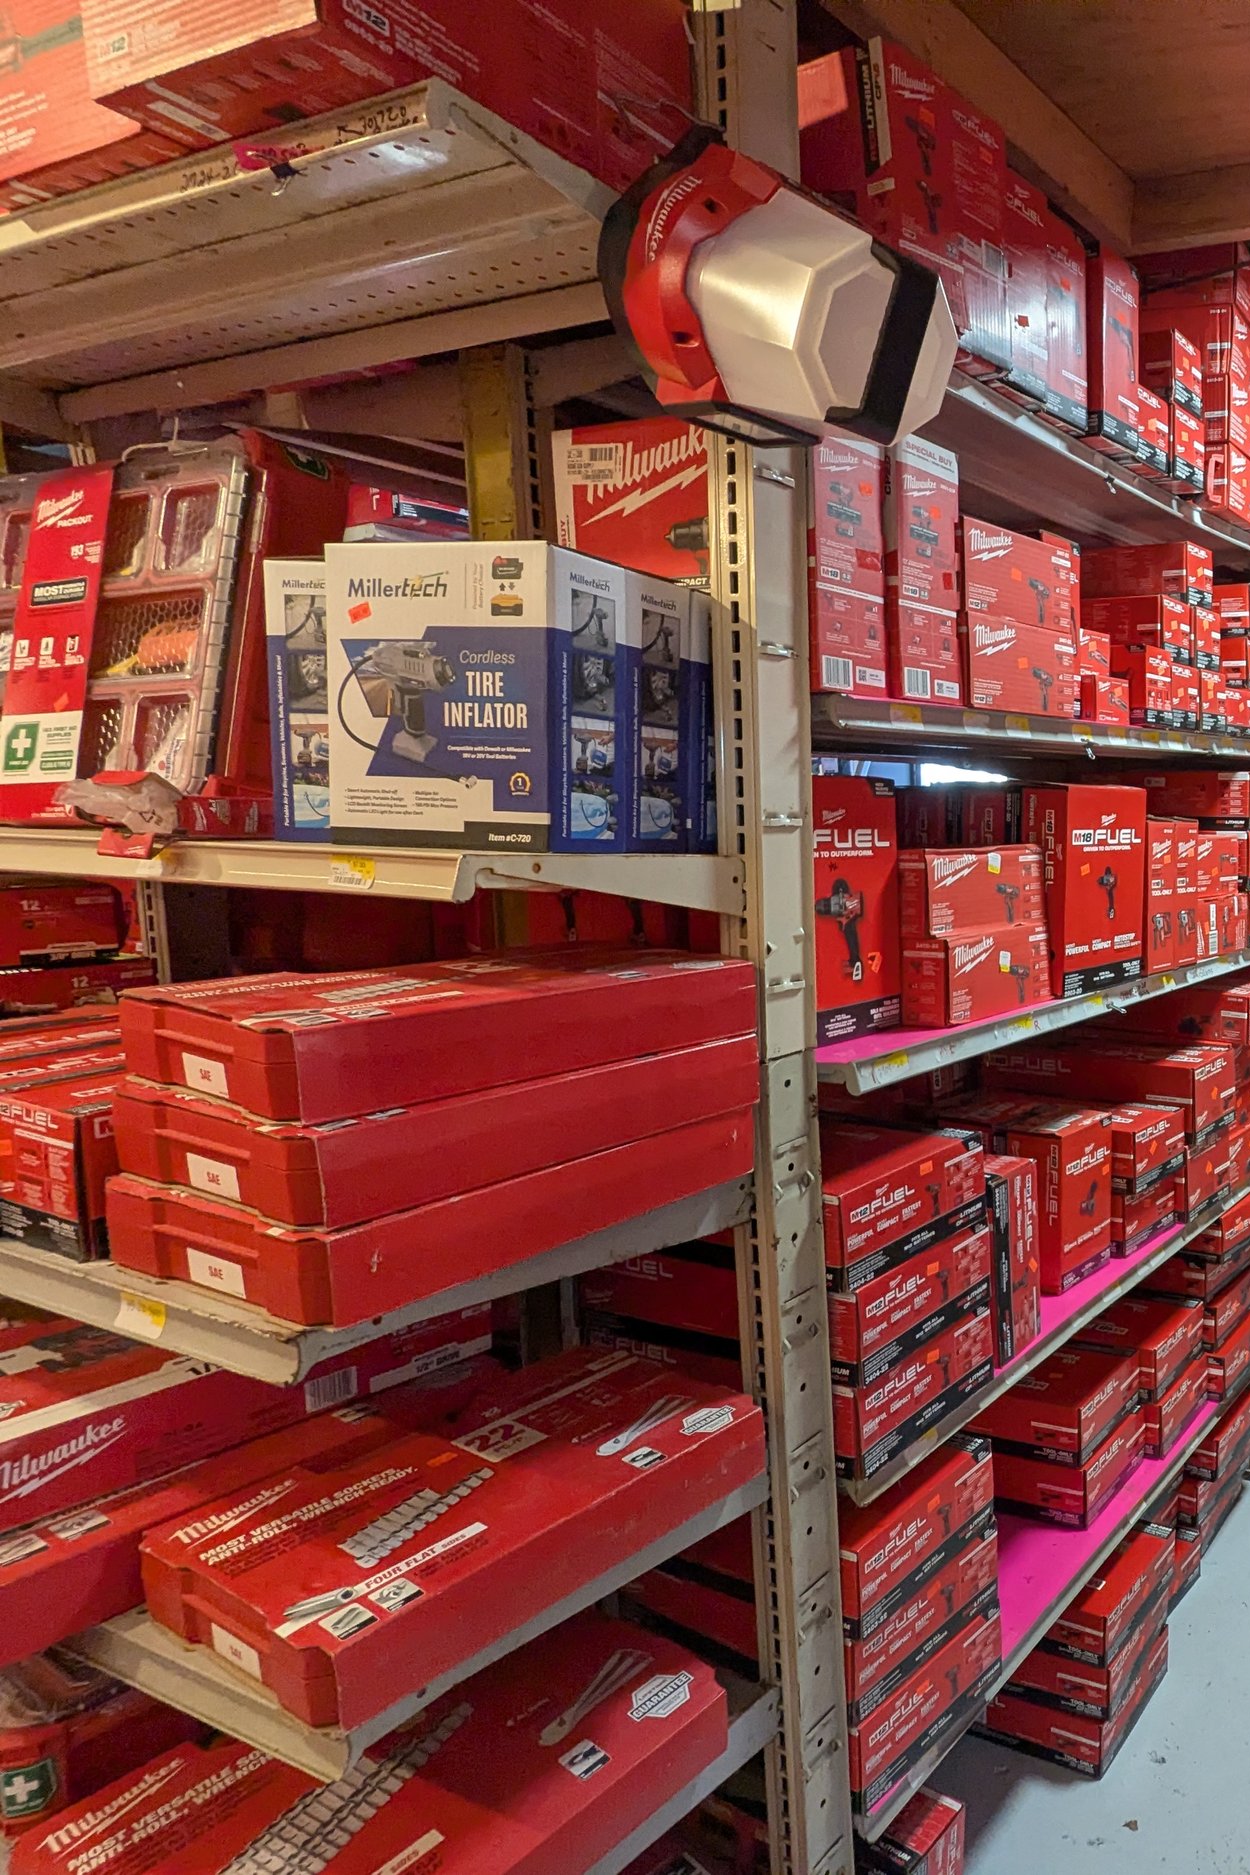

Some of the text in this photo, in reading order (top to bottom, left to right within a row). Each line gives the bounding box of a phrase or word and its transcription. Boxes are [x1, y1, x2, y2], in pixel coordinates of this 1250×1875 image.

[649, 175, 703, 262] Milwaukee
[818, 446, 859, 464] Milwaukee
[905, 440, 953, 466] SPECIAL BUY
[901, 474, 937, 490] Milwaukee
[36, 490, 84, 523] Milwaukee
[56, 514, 94, 529] PACKOUT
[968, 527, 1014, 552] Milwaukee
[34, 584, 63, 598] MOST
[282, 579, 326, 590] Millertec
[347, 571, 448, 600] Millertech
[569, 572, 611, 593] Millertech
[640, 593, 677, 611] Millertech
[973, 624, 1017, 648] Milwaukee
[459, 650, 516, 665] Cordless
[465, 671, 504, 697] TIRE
[444, 702, 528, 729] INFLATOR
[488, 833, 505, 842] Item
[813, 829, 890, 849] FUEL
[1073, 829, 1142, 845] M18 FUEL
[931, 854, 978, 881] Milwaukee
[952, 936, 995, 969] Milwaukee
[199, 1068, 213, 1082] SAE
[1204, 1057, 1228, 1076] FUEL
[11, 1104, 59, 1129] FUEL
[1146, 1120, 1171, 1140] FUEL
[1080, 1146, 1111, 1170] FUEL
[206, 1171, 221, 1186] SAE
[851, 1184, 916, 1223] M12 FUEL
[208, 1266, 224, 1281] SAE
[866, 1273, 926, 1316] M12 FUEL
[883, 1362, 927, 1397] FUEL
[1091, 1378, 1119, 1409] FUEL
[1098, 1436, 1125, 1469] FUEL
[167, 1478, 300, 1545] Milwaukee
[199, 1532, 247, 1562] MOST
[250, 1497, 330, 1536] VERSATILE
[884, 1517, 927, 1557] FUEL
[364, 1566, 401, 1590] FOUR
[404, 1547, 437, 1571] FLAT
[884, 1600, 929, 1639] FUEL
[631, 1672, 690, 1720] GUARANTEE
[196, 1751, 279, 1805] WRENCH
[36, 1757, 191, 1853] Milwaukee
[66, 1766, 236, 1872] MOST VERSATILE
